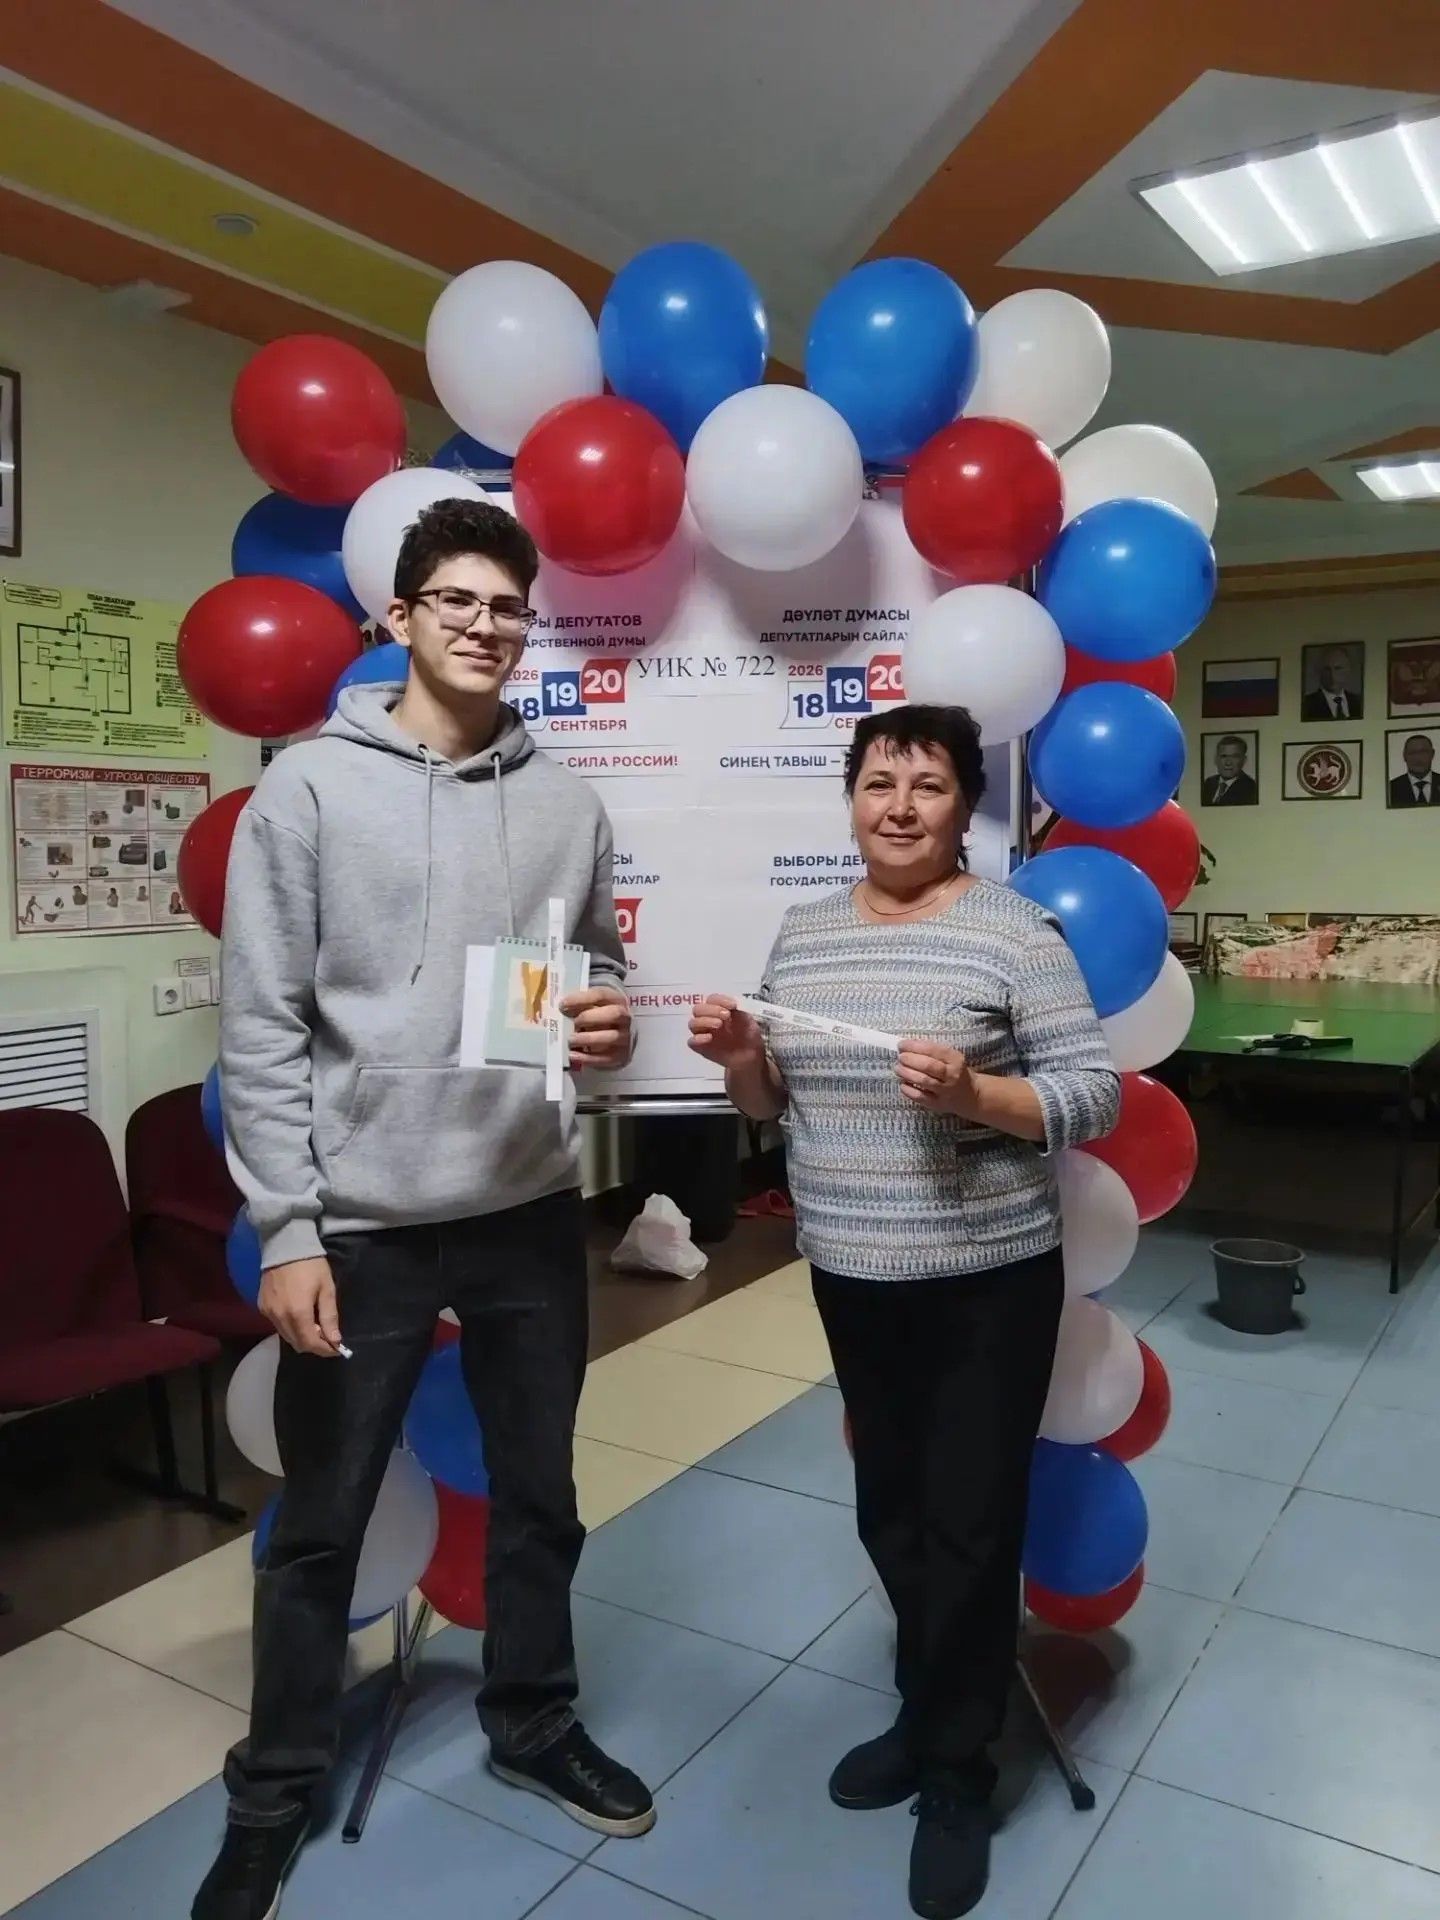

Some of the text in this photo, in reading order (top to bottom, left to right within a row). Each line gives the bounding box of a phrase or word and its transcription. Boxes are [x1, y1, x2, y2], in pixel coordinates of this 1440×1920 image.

[530, 615, 642, 629] РЫ ДЕПУТАТОВ
[783, 609, 910, 622] ДӘҮЛӘТ ДУМАСЫ
[523, 635, 645, 648] АРСТВЕННОЙ ДУМЫ
[760, 629, 908, 643] ДЕПУТАТЛАРЫН САЙЛА
[635, 657, 693, 678] УИК
[736, 655, 775, 676] 722
[788, 665, 823, 676] 2026
[508, 670, 538, 680] 026
[584, 669, 622, 694] 20
[870, 665, 903, 691] 20
[545, 682, 577, 707] 19
[831, 678, 863, 704] 19
[793, 693, 824, 718] 18
[551, 720, 627, 731] СЕНТЯБРЯ
[568, 757, 608, 768] СИЛА
[612, 755, 678, 767] РОССИИ!
[720, 757, 771, 769] СИНЕҢ
[774, 756, 827, 767] ТАВЫШ
[20, 766, 94, 781] ТЕРРОРИЗМ
[104, 771, 144, 783] УГРОЗА
[147, 773, 201, 785] ОБЩЕСТВУ
[612, 854, 632, 865] СЫ
[773, 856, 837, 867] ВЫБОРЫ
[612, 875, 660, 885] ЛАУЛАР
[615, 908, 633, 934] 0
[629, 996, 660, 1007] НЕҢ
